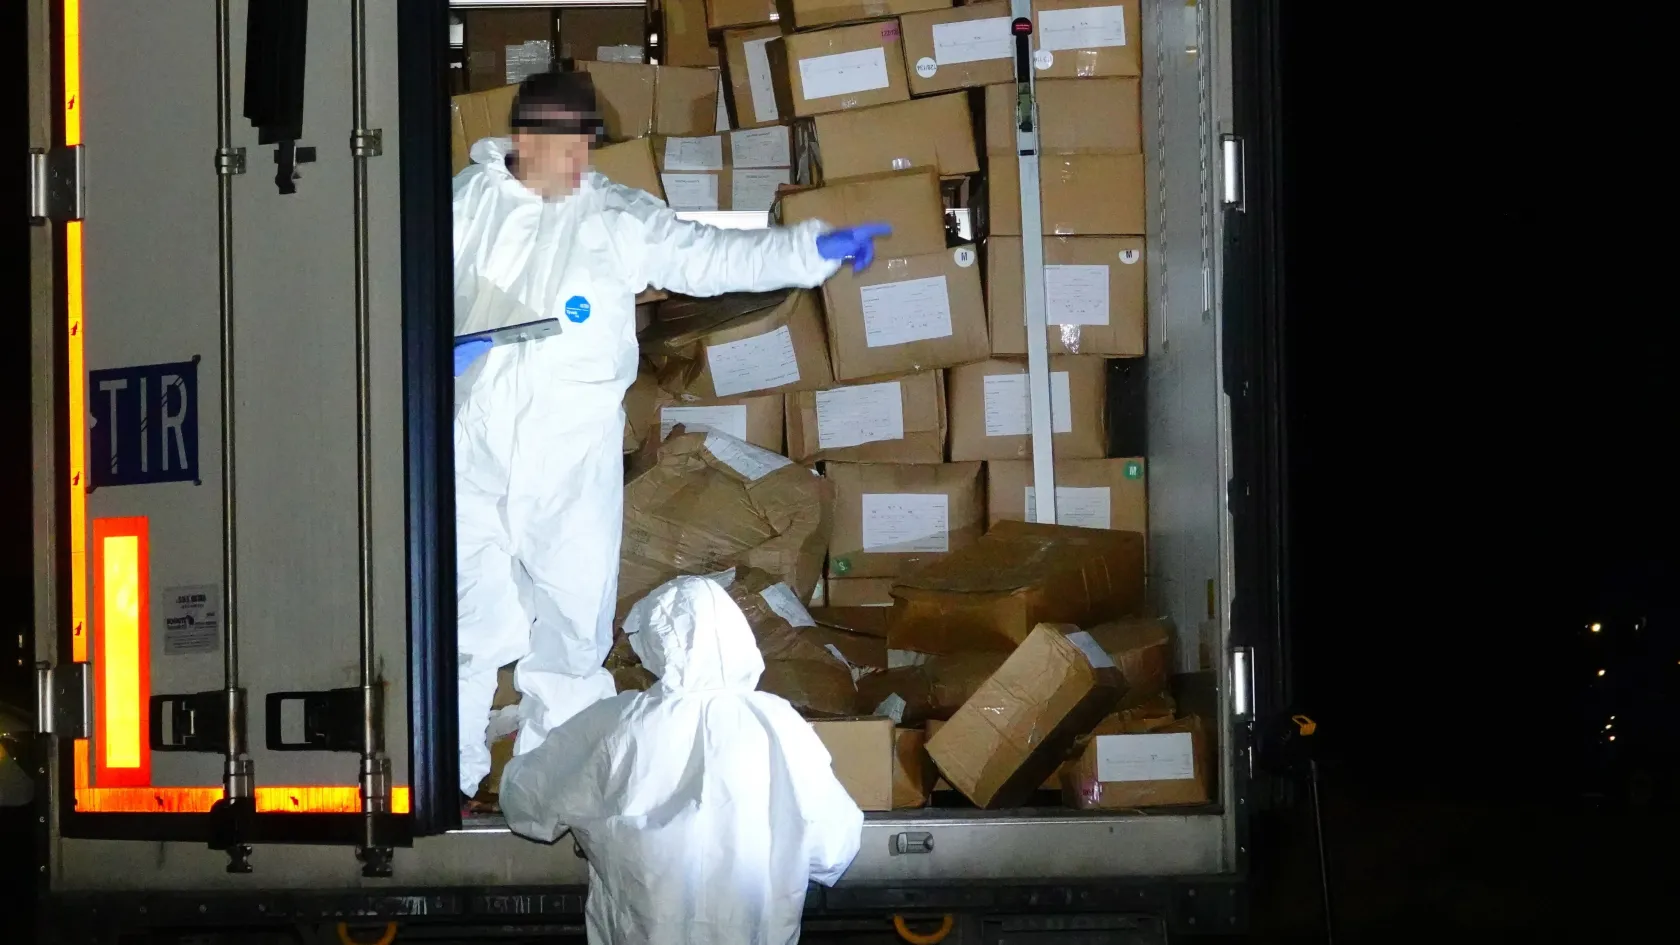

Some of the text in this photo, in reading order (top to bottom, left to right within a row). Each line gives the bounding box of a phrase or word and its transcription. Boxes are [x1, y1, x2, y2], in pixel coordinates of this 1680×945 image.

[961, 251, 968, 262] M
[1125, 249, 1133, 259] M
[99, 374, 188, 475] TIR
